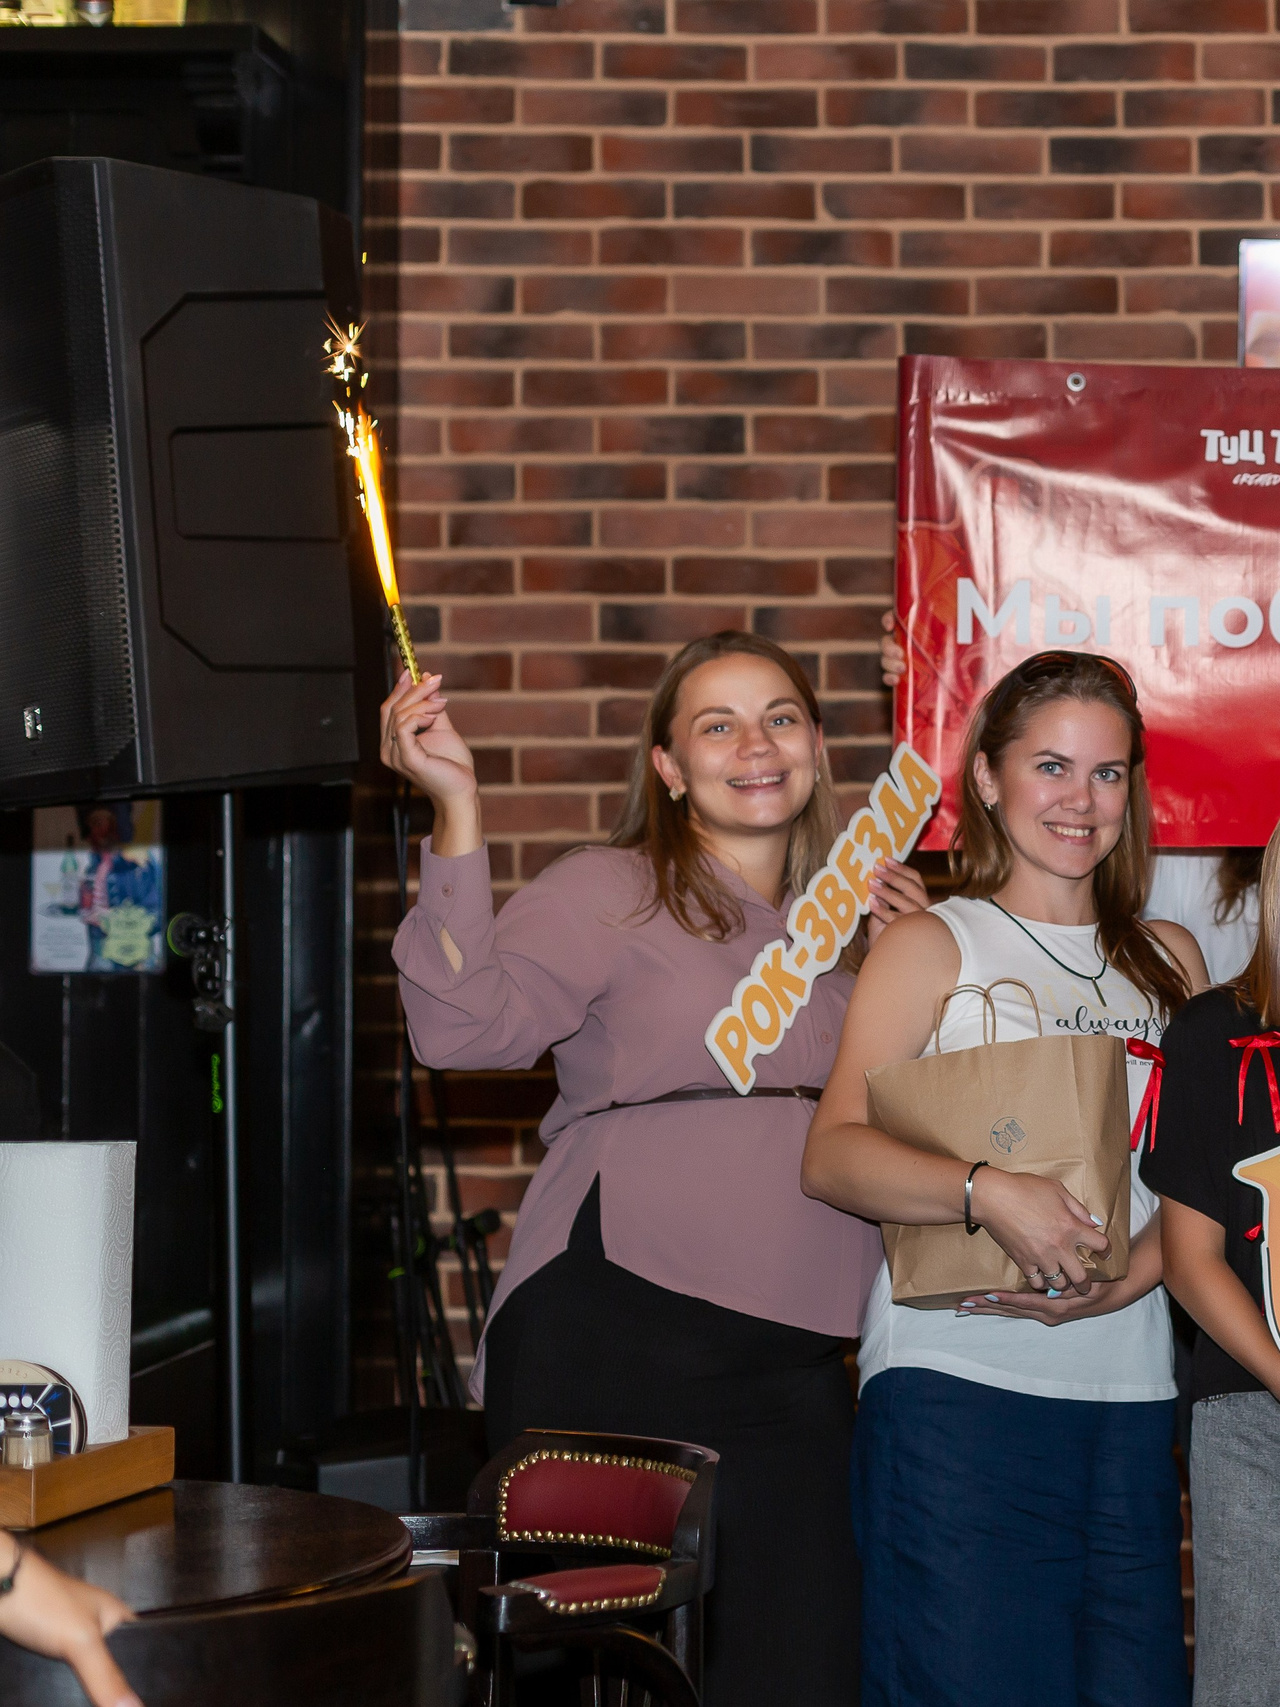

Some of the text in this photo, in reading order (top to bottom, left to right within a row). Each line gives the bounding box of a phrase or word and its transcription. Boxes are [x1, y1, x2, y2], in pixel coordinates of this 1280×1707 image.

[955, 576, 1112, 646] Мы
[713, 751, 938, 1086] РОК-ЗВЕЗДА
[1055, 1004, 1164, 1041] always
